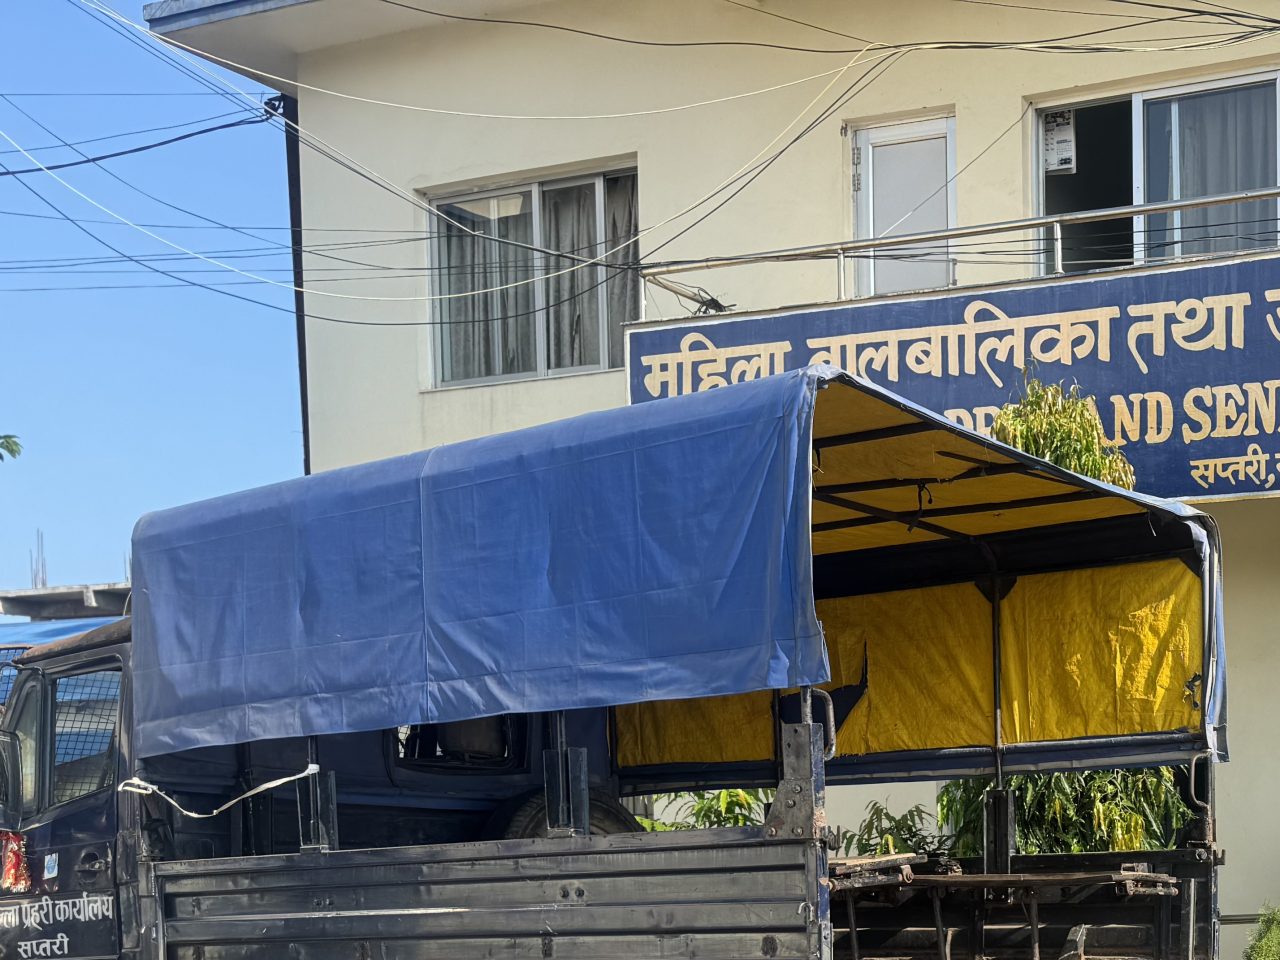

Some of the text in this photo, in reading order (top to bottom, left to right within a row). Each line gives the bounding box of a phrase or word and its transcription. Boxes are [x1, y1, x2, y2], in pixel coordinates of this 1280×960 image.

[641, 333, 792, 398] महिला
[1127, 292, 1251, 374] तथा
[21, 895, 54, 931] प्रहरी
[55, 891, 114, 922] कार्यालय
[17, 932, 70, 959] सप्तरी
